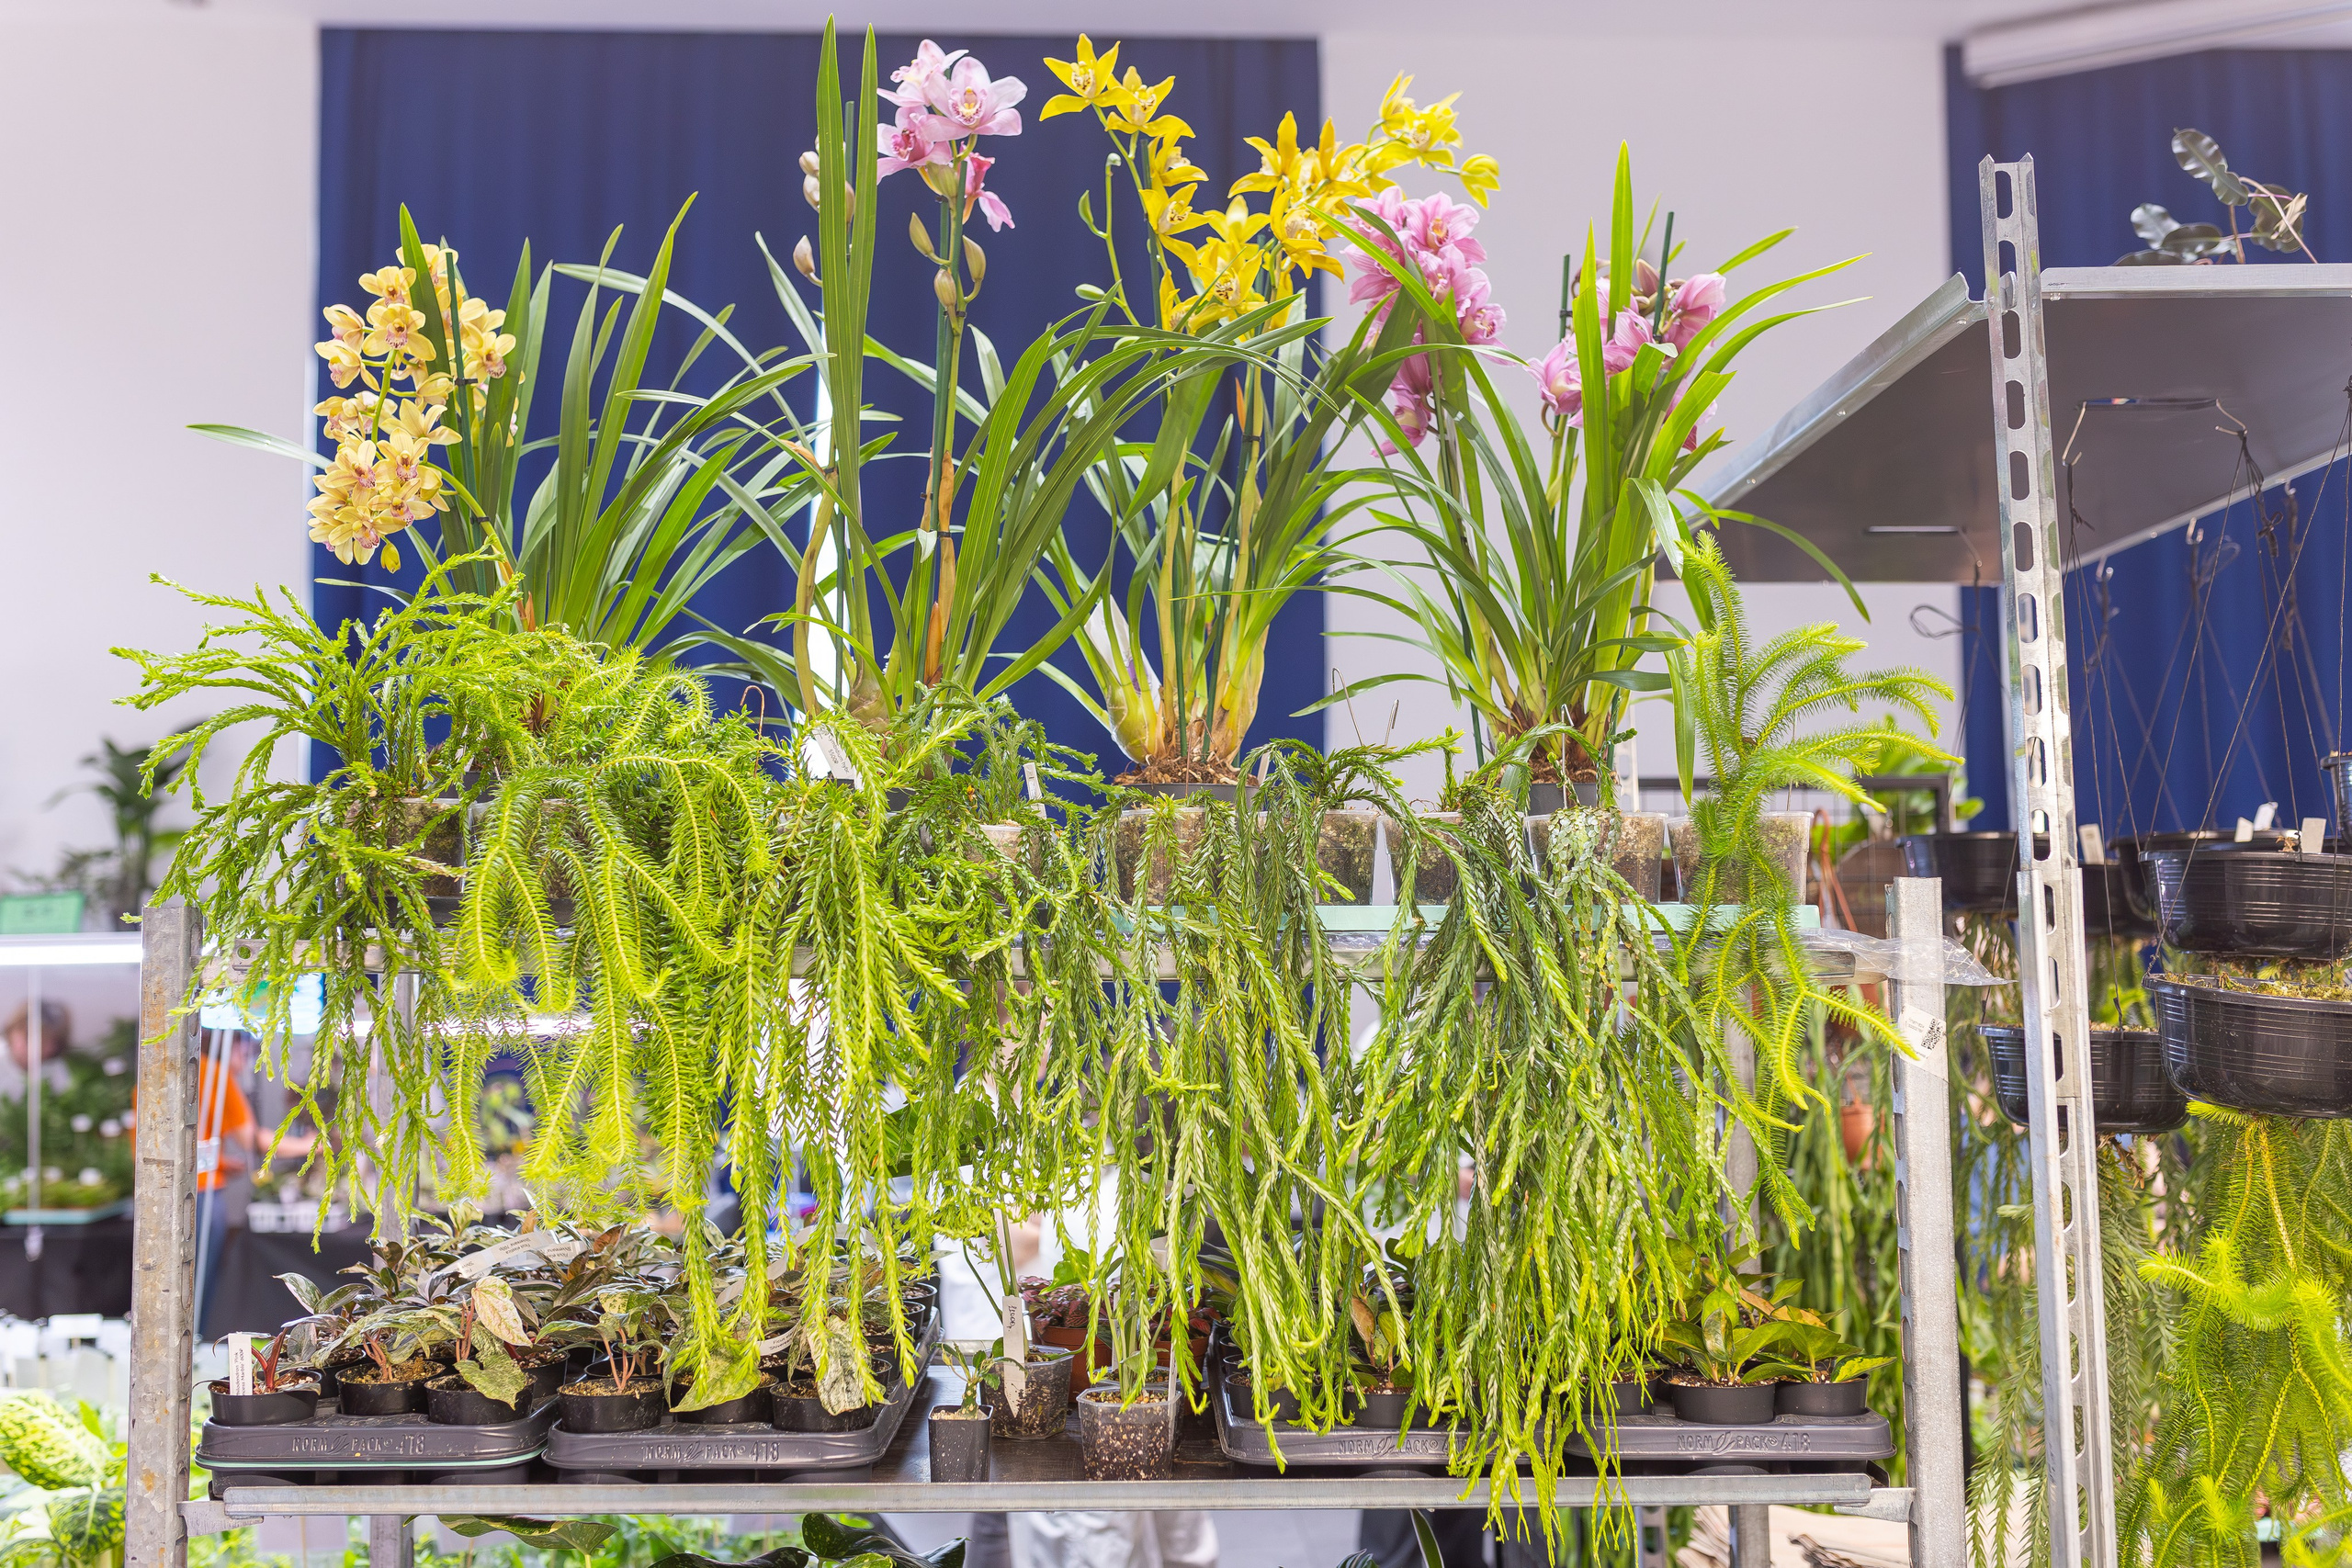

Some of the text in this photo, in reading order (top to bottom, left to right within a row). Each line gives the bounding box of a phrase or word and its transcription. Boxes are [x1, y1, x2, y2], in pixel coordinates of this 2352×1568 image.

[292, 1437, 328, 1452] NORM
[645, 1444, 682, 1460] NORM
[749, 1440, 780, 1461] 418
[1338, 1439, 1374, 1454] NORM
[1677, 1435, 1714, 1450] NORM
[1781, 1432, 1811, 1453] 418
